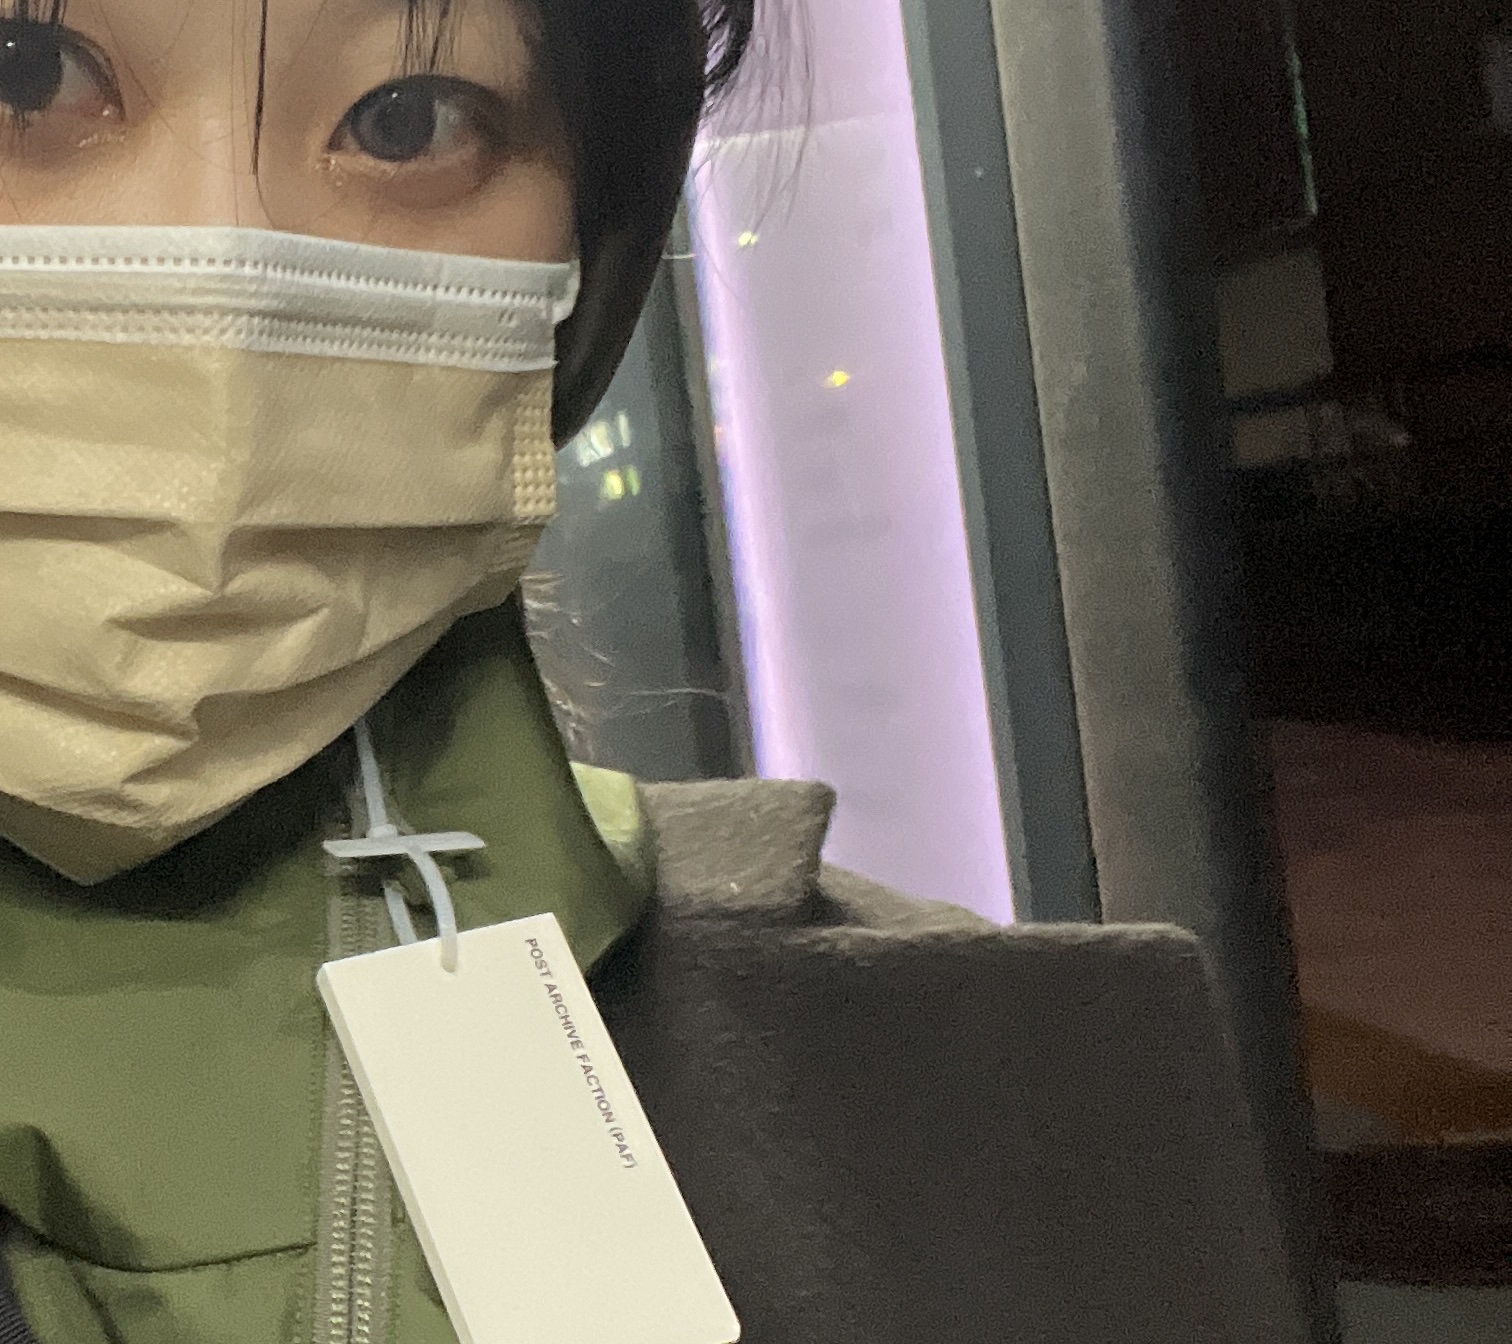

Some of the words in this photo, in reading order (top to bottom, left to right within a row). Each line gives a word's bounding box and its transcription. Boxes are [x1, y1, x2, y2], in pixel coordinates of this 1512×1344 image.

[525, 938, 553, 978] POST
[544, 983, 585, 1051] ARCHIVE
[576, 1054, 617, 1123] FACTION
[608, 1127, 638, 1168] (PAF)
